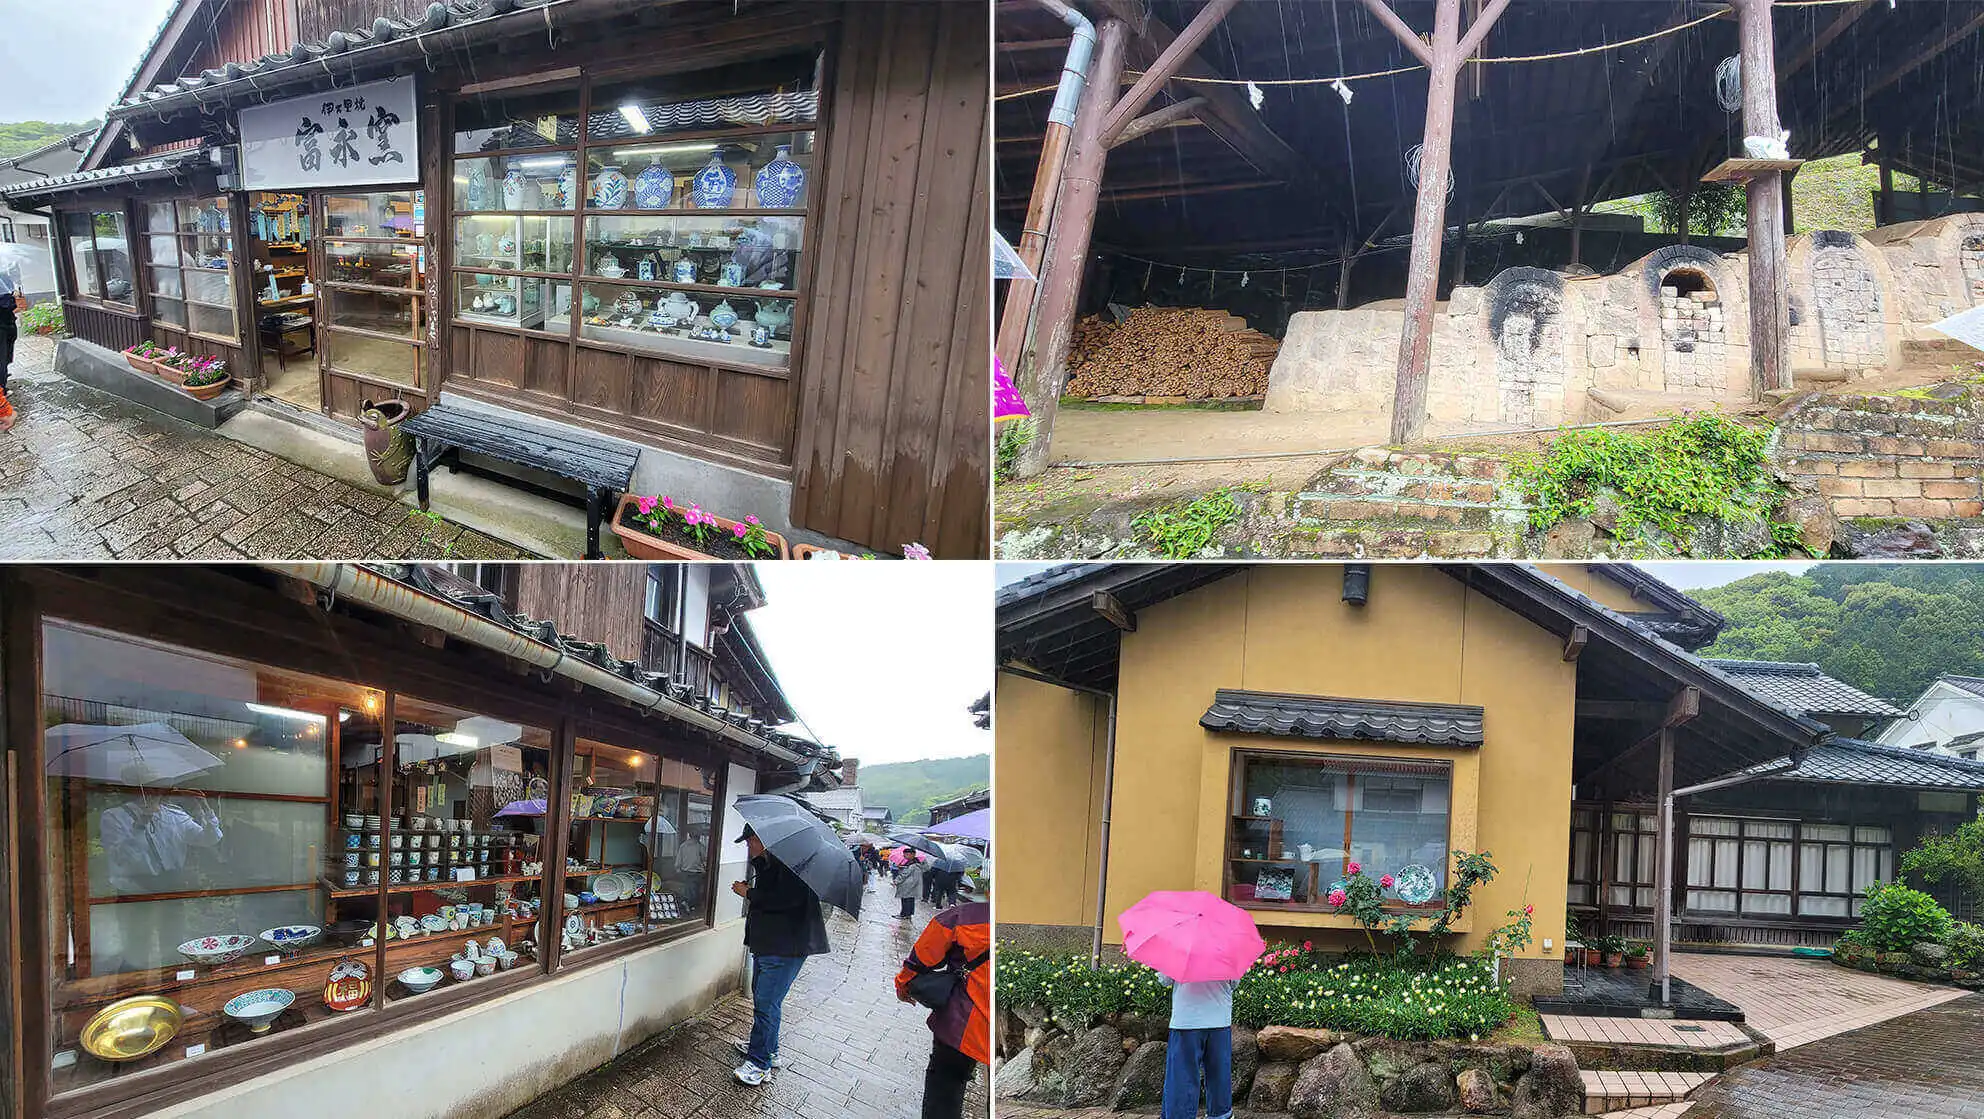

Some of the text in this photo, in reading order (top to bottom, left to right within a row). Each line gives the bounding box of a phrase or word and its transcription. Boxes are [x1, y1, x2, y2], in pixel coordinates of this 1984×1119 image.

[321, 96, 367, 116] 伊万里焼
[295, 106, 404, 172] 富永窯
[336, 980, 358, 1003] 福
